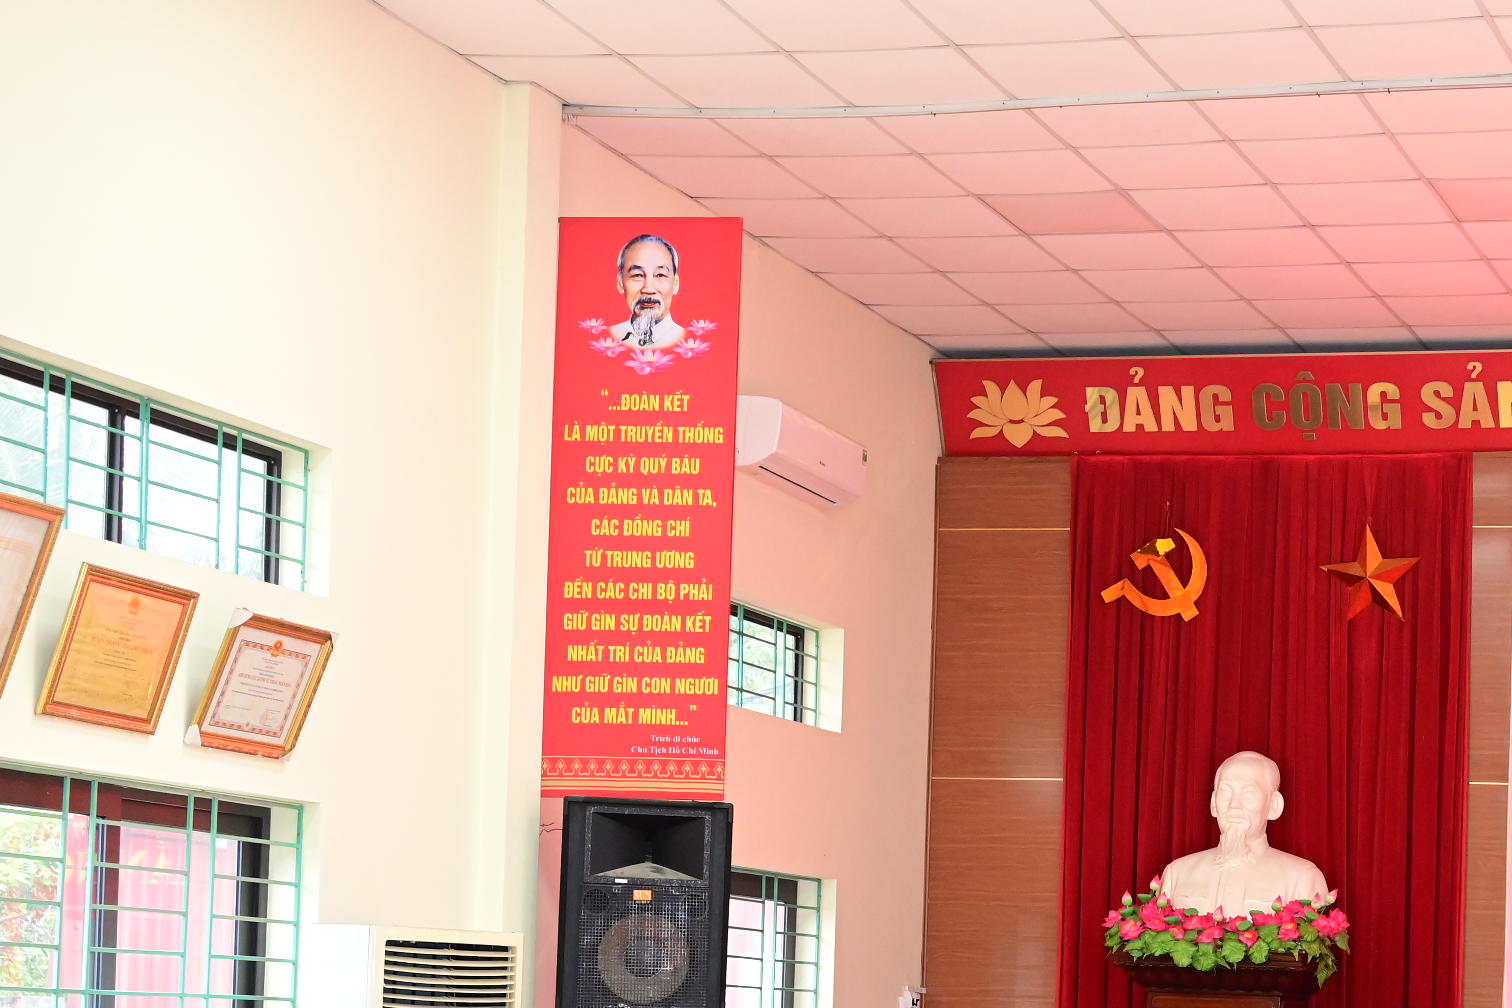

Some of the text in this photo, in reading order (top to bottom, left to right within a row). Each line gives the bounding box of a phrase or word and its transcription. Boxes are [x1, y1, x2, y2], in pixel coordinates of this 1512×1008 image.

[664, 390, 690, 411] KẾT
[1085, 367, 1234, 432] ĐẢNG
[1252, 371, 1402, 440] CỘNG
[564, 423, 580, 441] LÀ
[586, 422, 615, 444] MỘT
[678, 421, 723, 443] THỐNG
[586, 454, 700, 475] CỰC KỲ QUÝ BÁU
[567, 482, 716, 506] CỦA ĐẢNG VÀ DÂN TA,
[592, 516, 619, 536] CÁC
[667, 517, 690, 536] CHÍ
[585, 547, 694, 568] TỪ TRUNG ƯƠNG
[564, 577, 712, 603] ĐẾN CÁC CHI BỘ PHẢI
[564, 611, 711, 634] GIỮ GÌN SỰ ĐOÀN KẾT
[568, 640, 704, 663] NHẤT TRÍ CỦA ĐẢNG
[552, 676, 582, 692] NHƯ
[586, 674, 610, 692] GIỮ
[613, 674, 637, 693] GÌN
[642, 678, 670, 693] CON
[572, 702, 599, 723] CỦA
[605, 702, 634, 724] MẮT
